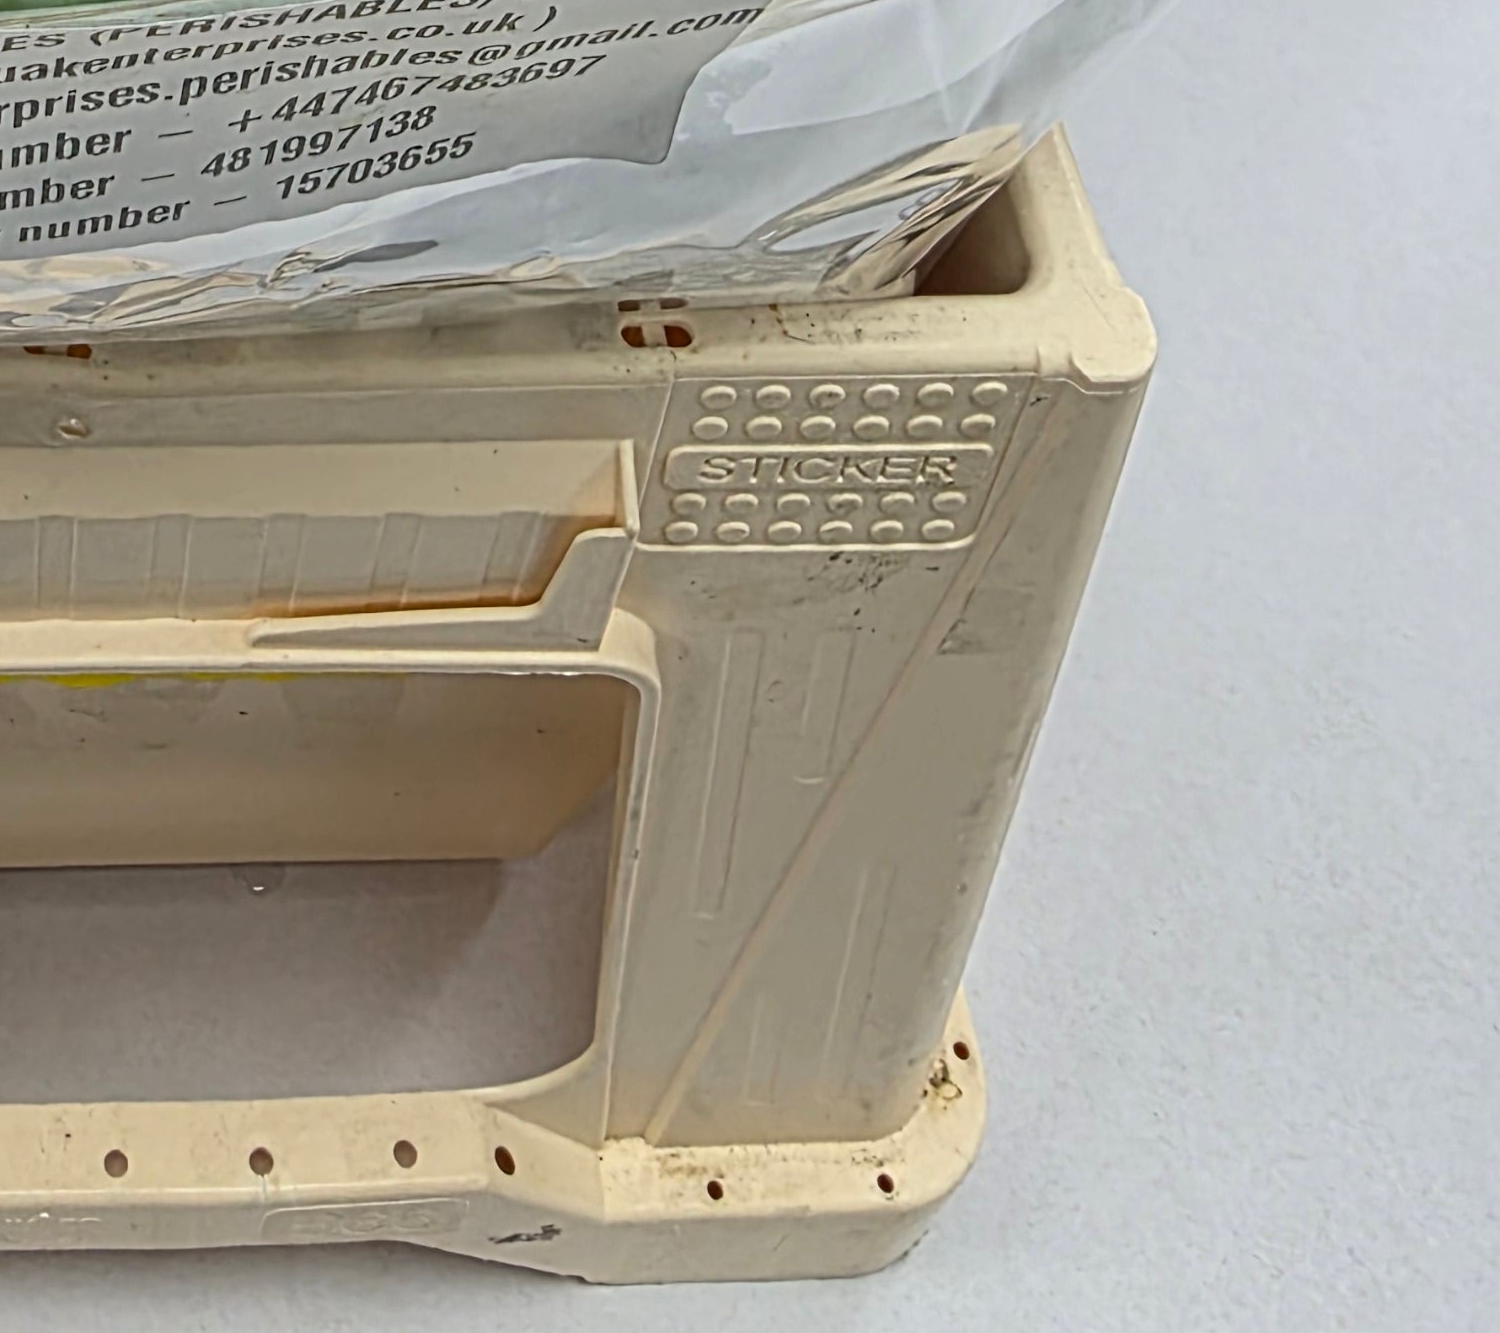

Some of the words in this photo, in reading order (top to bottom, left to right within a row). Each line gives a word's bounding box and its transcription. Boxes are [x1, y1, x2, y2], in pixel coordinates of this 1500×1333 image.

[200, 104, 438, 178] 481997138
[18, 200, 191, 244] number
[276, 131, 478, 200] 15703655
[700, 454, 958, 486] STICKER
